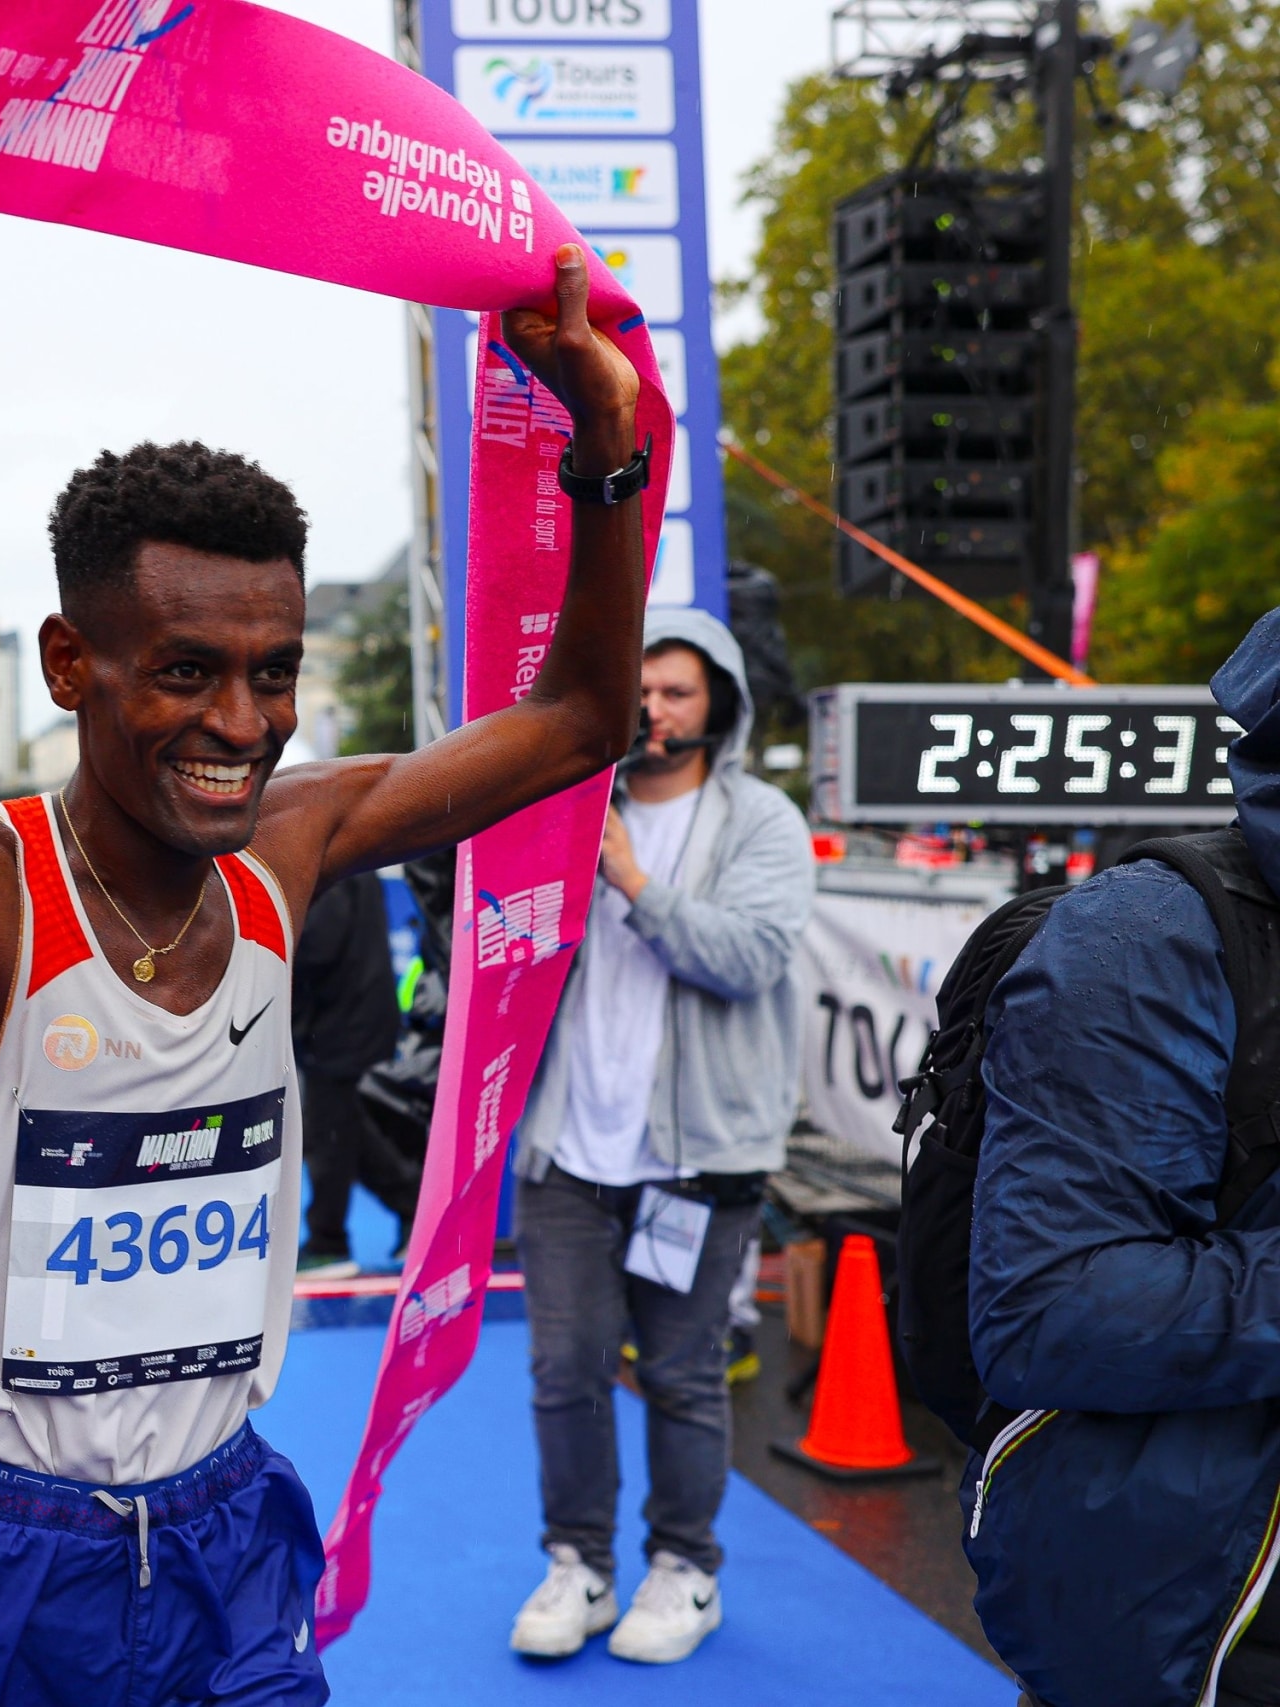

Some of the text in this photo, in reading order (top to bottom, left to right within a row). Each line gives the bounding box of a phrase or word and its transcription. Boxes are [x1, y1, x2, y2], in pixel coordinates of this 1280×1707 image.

[485, 0, 643, 25] TOURS
[54, 46, 143, 112] LOIRE
[553, 58, 637, 86] Tours
[326, 116, 504, 204] République
[362, 170, 534, 254] la Nouvelle
[481, 368, 531, 448] VALLEY
[530, 518, 560, 552] sport
[104, 1038, 142, 1060] NN
[136, 1127, 221, 1167] MARATHON
[46, 1193, 270, 1286] 43694
[47, 1368, 75, 1377] TOURS
[181, 1363, 207, 1375] SKF
